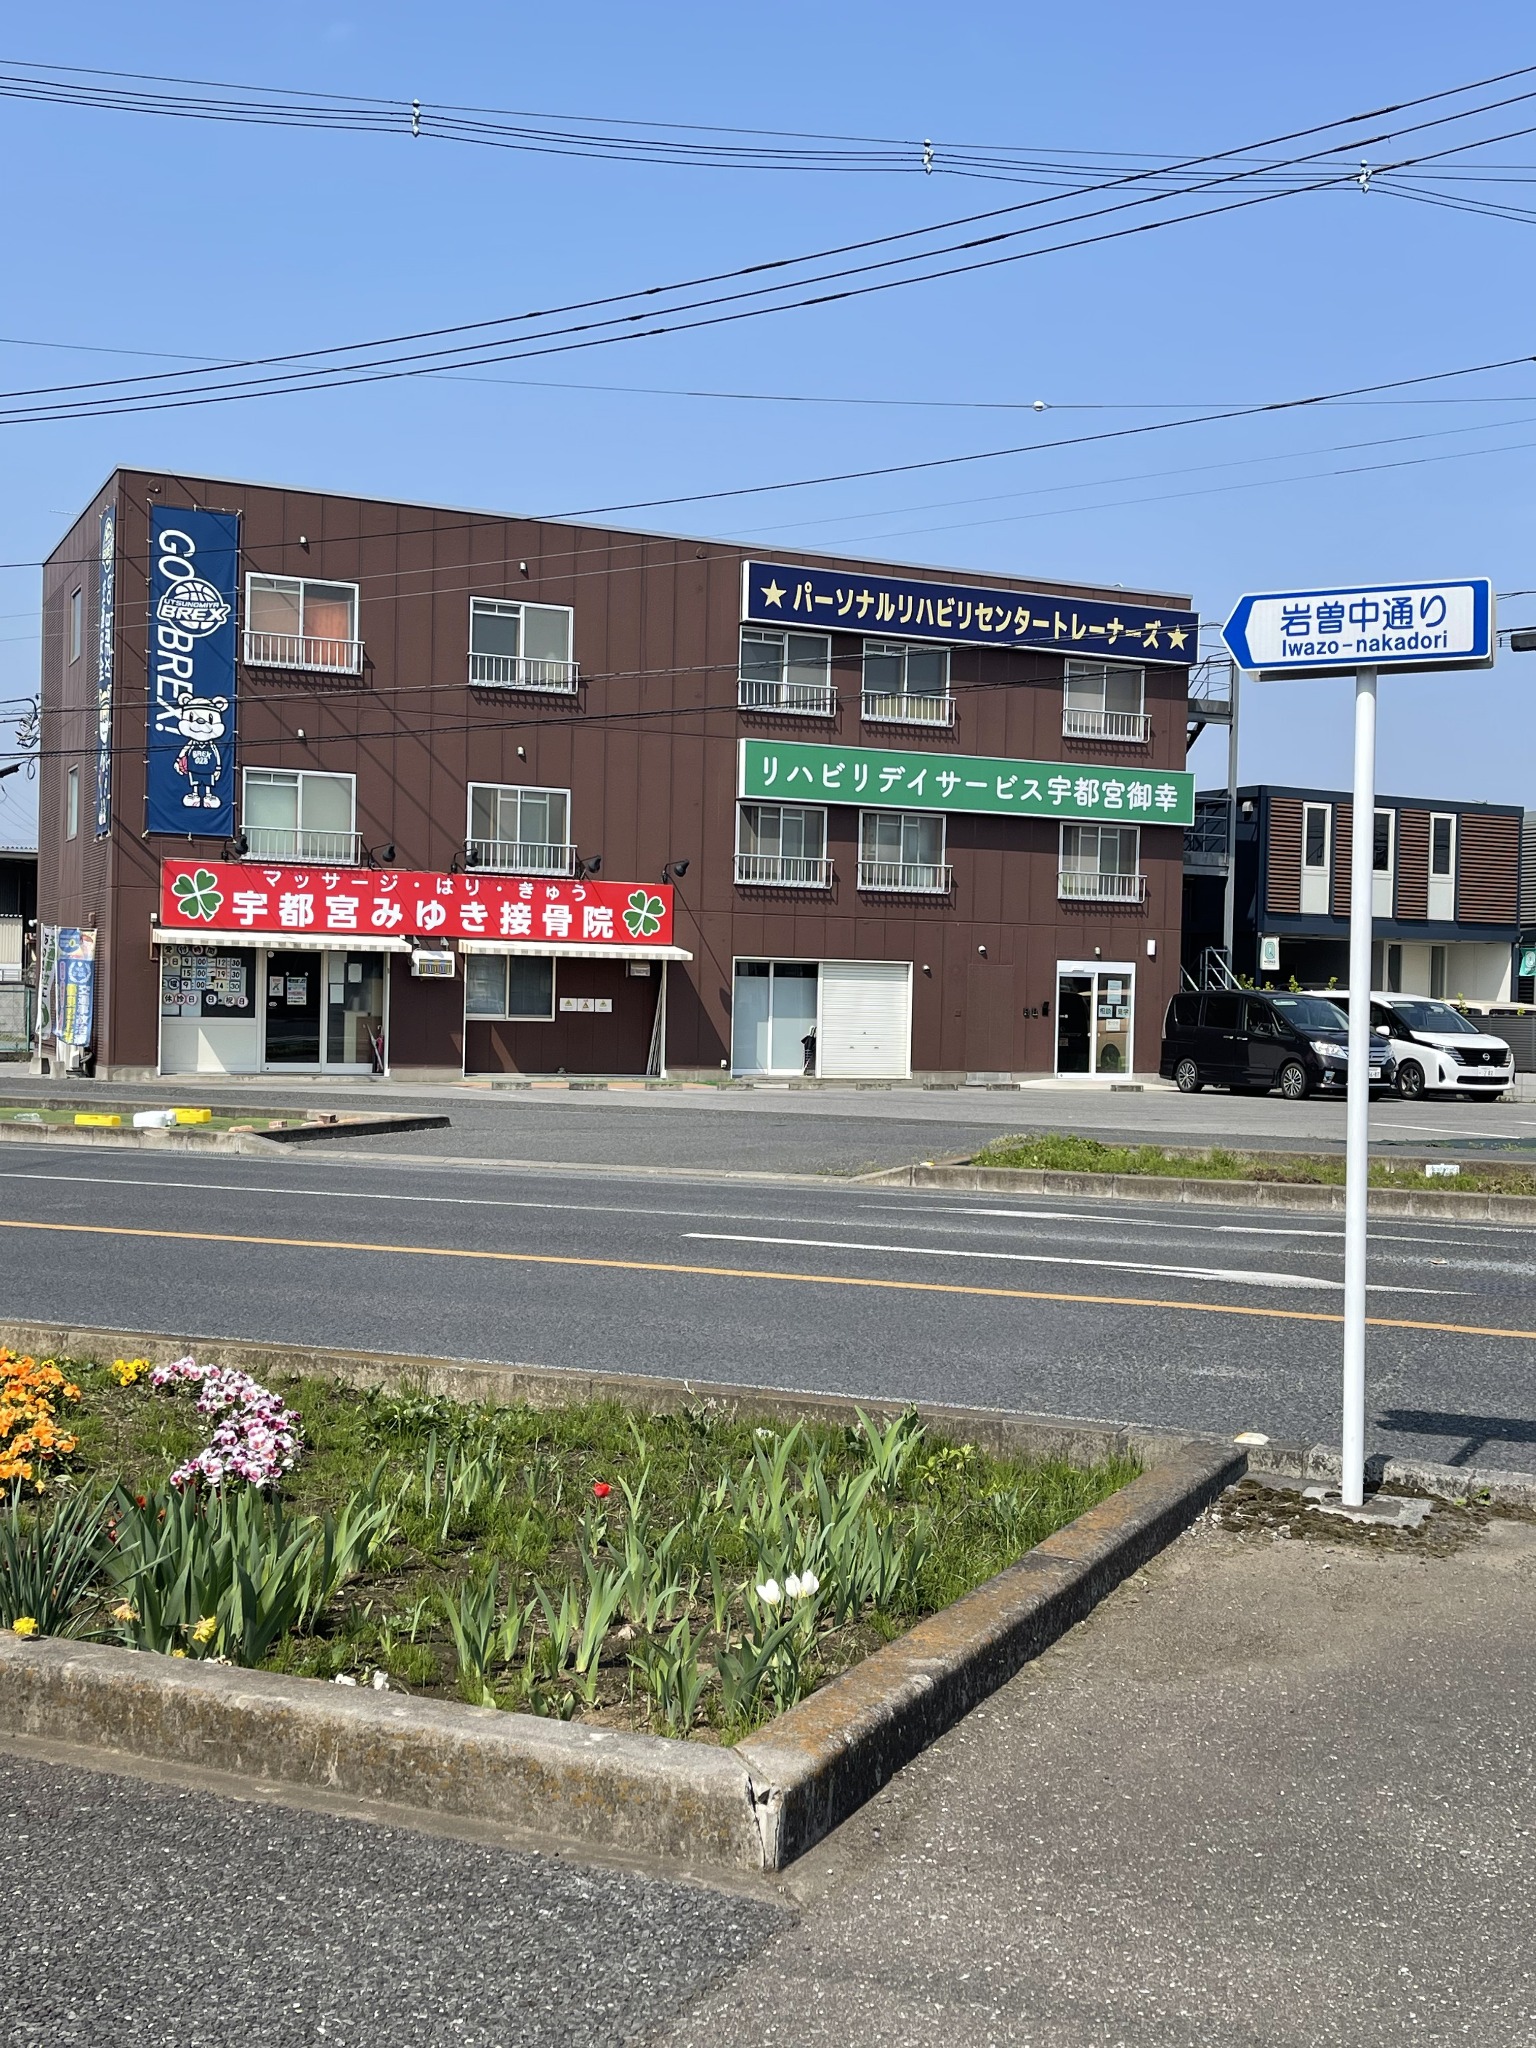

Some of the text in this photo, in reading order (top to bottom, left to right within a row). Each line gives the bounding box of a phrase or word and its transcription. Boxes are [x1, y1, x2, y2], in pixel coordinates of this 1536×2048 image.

[160, 604, 227, 621] BREX
[163, 598, 220, 608] UTSUNOMIYA
[793, 581, 1162, 649] パーソナルリハビリセンタートレーナーズ
[1280, 595, 1447, 637] 岩曽中通り
[155, 529, 195, 735] GO BREX!
[1282, 630, 1448, 657] Iwazo-nakadori
[192, 750, 212, 759] BREX
[763, 756, 1178, 812] リハビリデイサービス宇都宮御幸
[232, 891, 613, 938] 宇都宮みゆき接骨院
